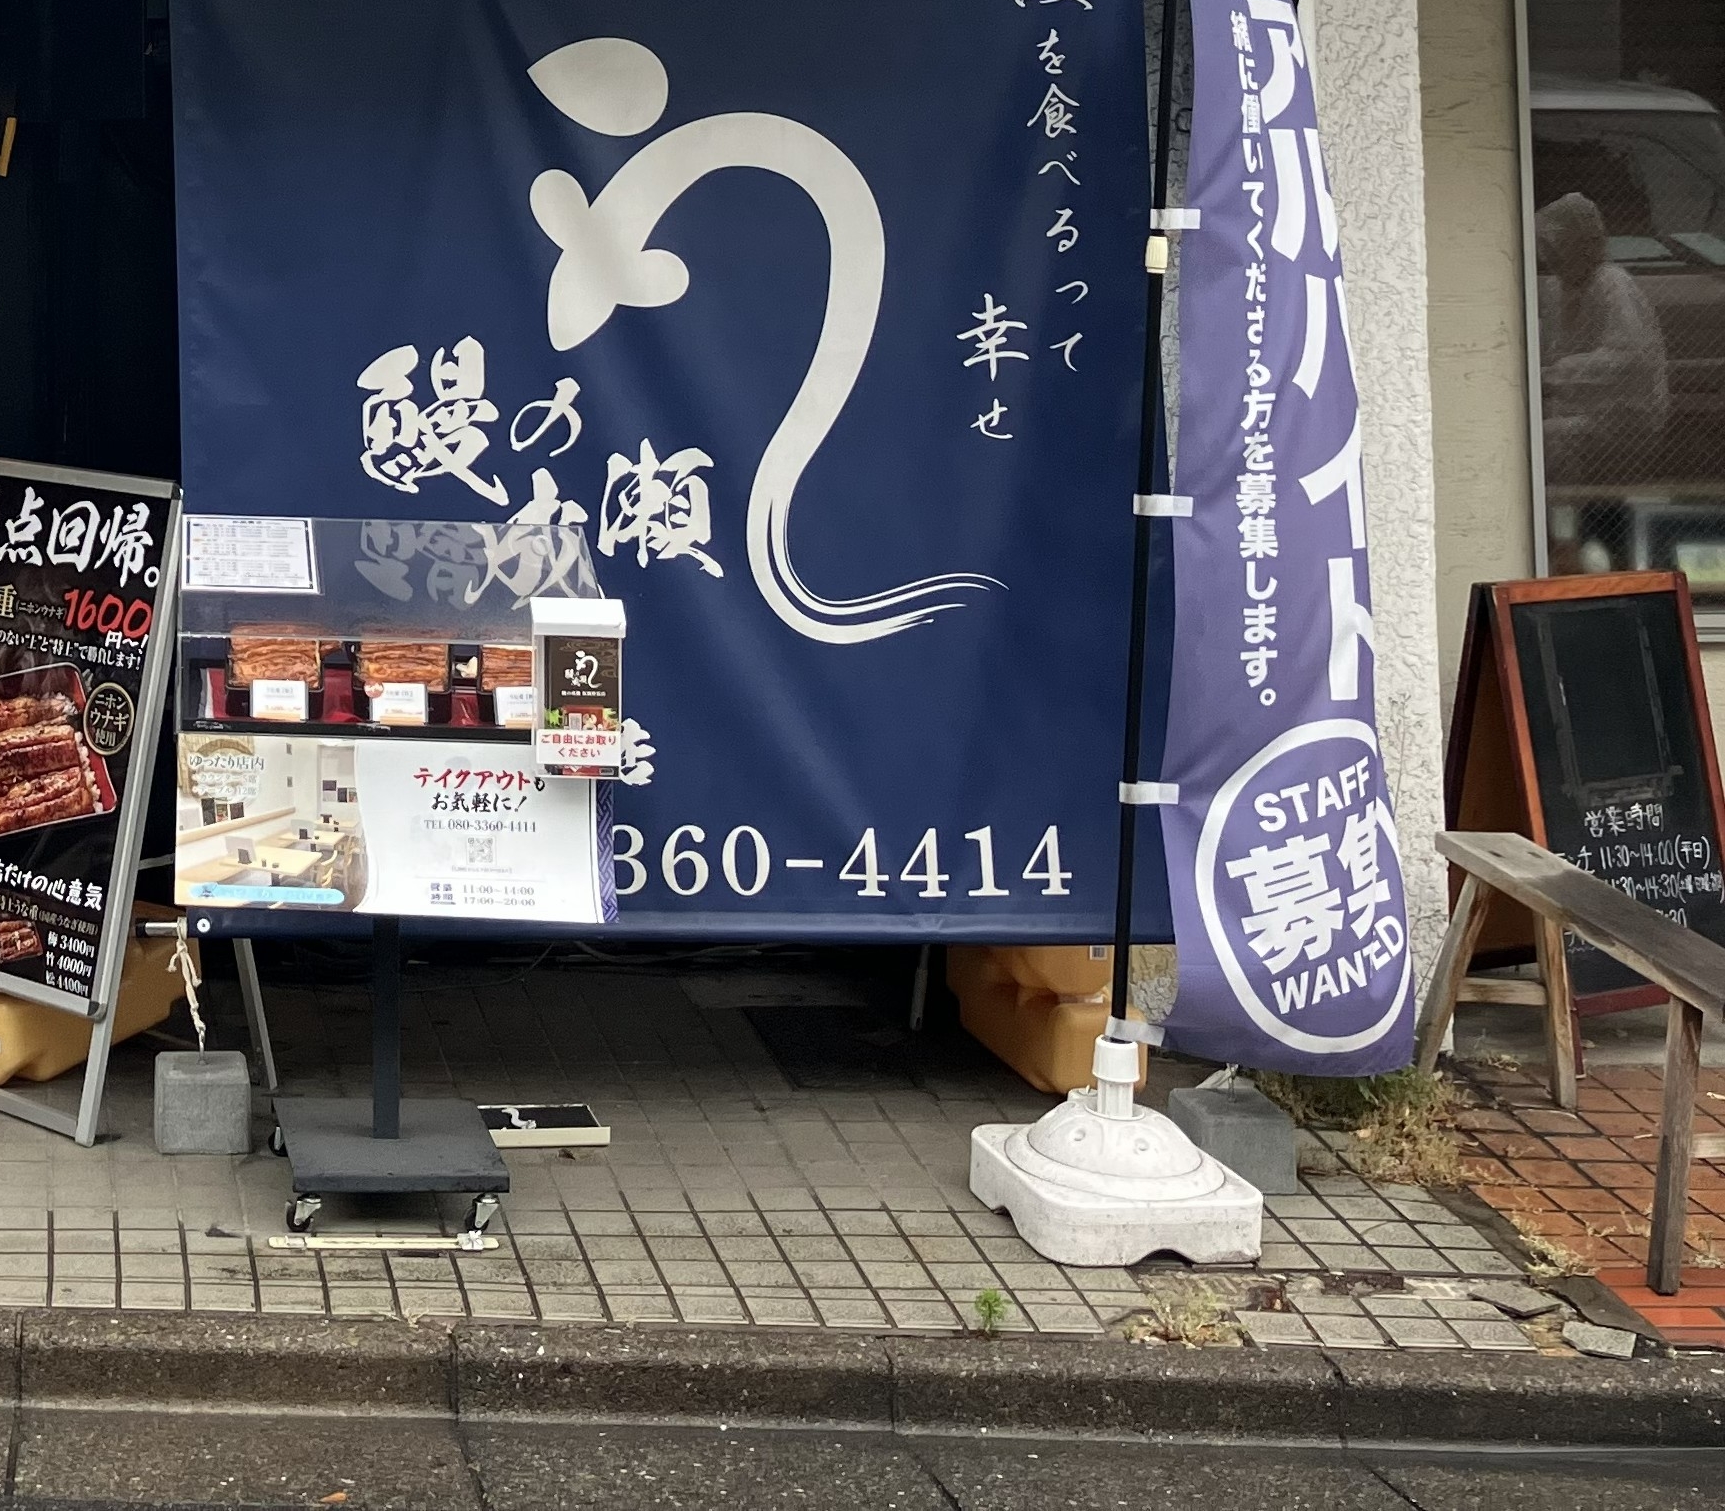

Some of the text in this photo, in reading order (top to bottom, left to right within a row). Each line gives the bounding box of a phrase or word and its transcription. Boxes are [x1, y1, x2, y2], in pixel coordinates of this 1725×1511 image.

[957, 293, 1031, 441] 幸せ
[64, 589, 152, 639] 1600
[94, 694, 126, 709] ニホン
[89, 709, 128, 732] ウナギ
[540, 733, 617, 745] ご自由にお取り
[189, 755, 265, 771] ゆったり店内
[558, 747, 601, 758] ください
[413, 767, 546, 792] テイクアウトも
[431, 792, 528, 813] お気軽に!
[1254, 756, 1371, 833] STAFF
[424, 819, 536, 833] TEL 080-3360-4414
[1584, 803, 1665, 838] 営業時間
